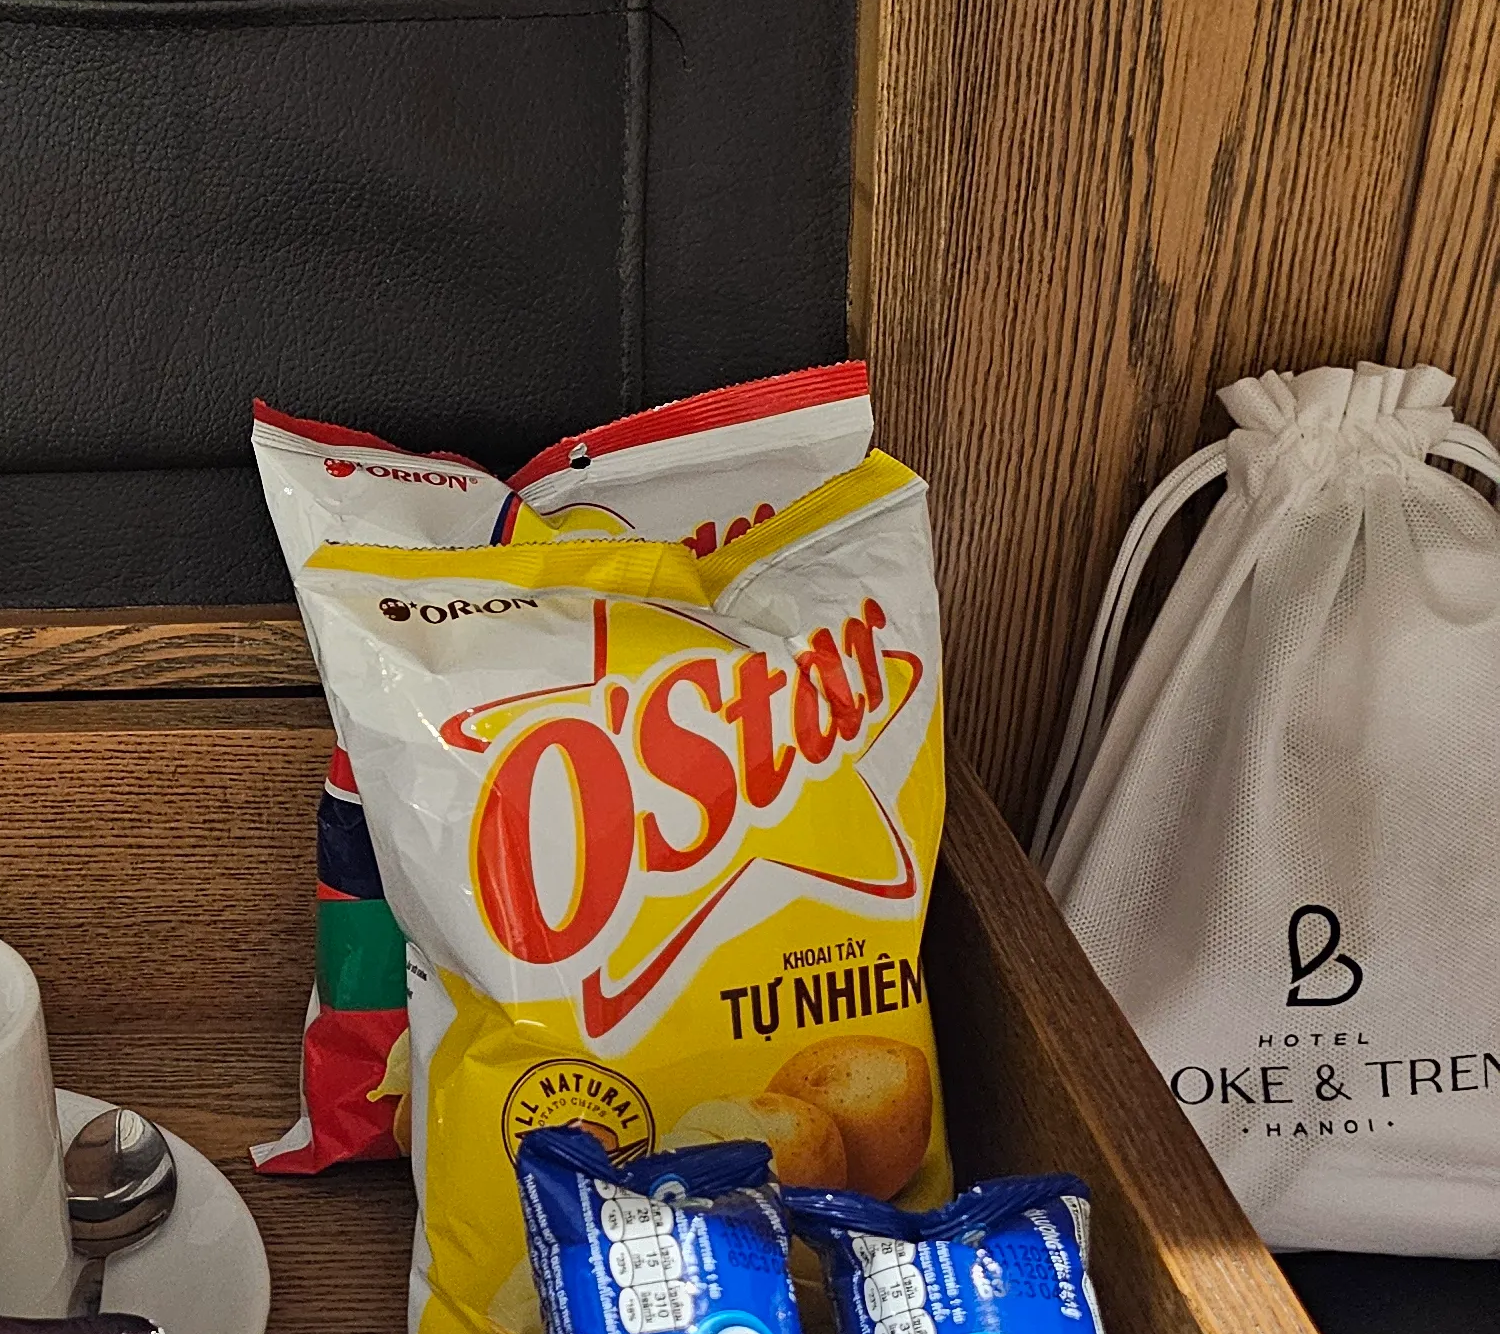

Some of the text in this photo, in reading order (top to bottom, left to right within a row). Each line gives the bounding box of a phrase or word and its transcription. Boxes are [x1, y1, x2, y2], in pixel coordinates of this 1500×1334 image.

[365, 465, 467, 491] ORION
[420, 597, 538, 626] ORION
[472, 597, 887, 965] O'Star
[782, 937, 867, 971] KHOAI TÂY
[720, 953, 923, 1041] TỰ NHIÊN
[1259, 1033, 1368, 1047] HOTEL
[1316, 1064, 1351, 1101] &
[1365, 1053, 1500, 1098] TREN
[538, 1097, 607, 1126] OTATO CHIPS
[540, 1073, 639, 1129] NATURAL
[1267, 1119, 1374, 1136] HANOI
[646, 1253, 658, 1268] 15
[890, 1283, 903, 1299] 15
[654, 1294, 669, 1318] 310
